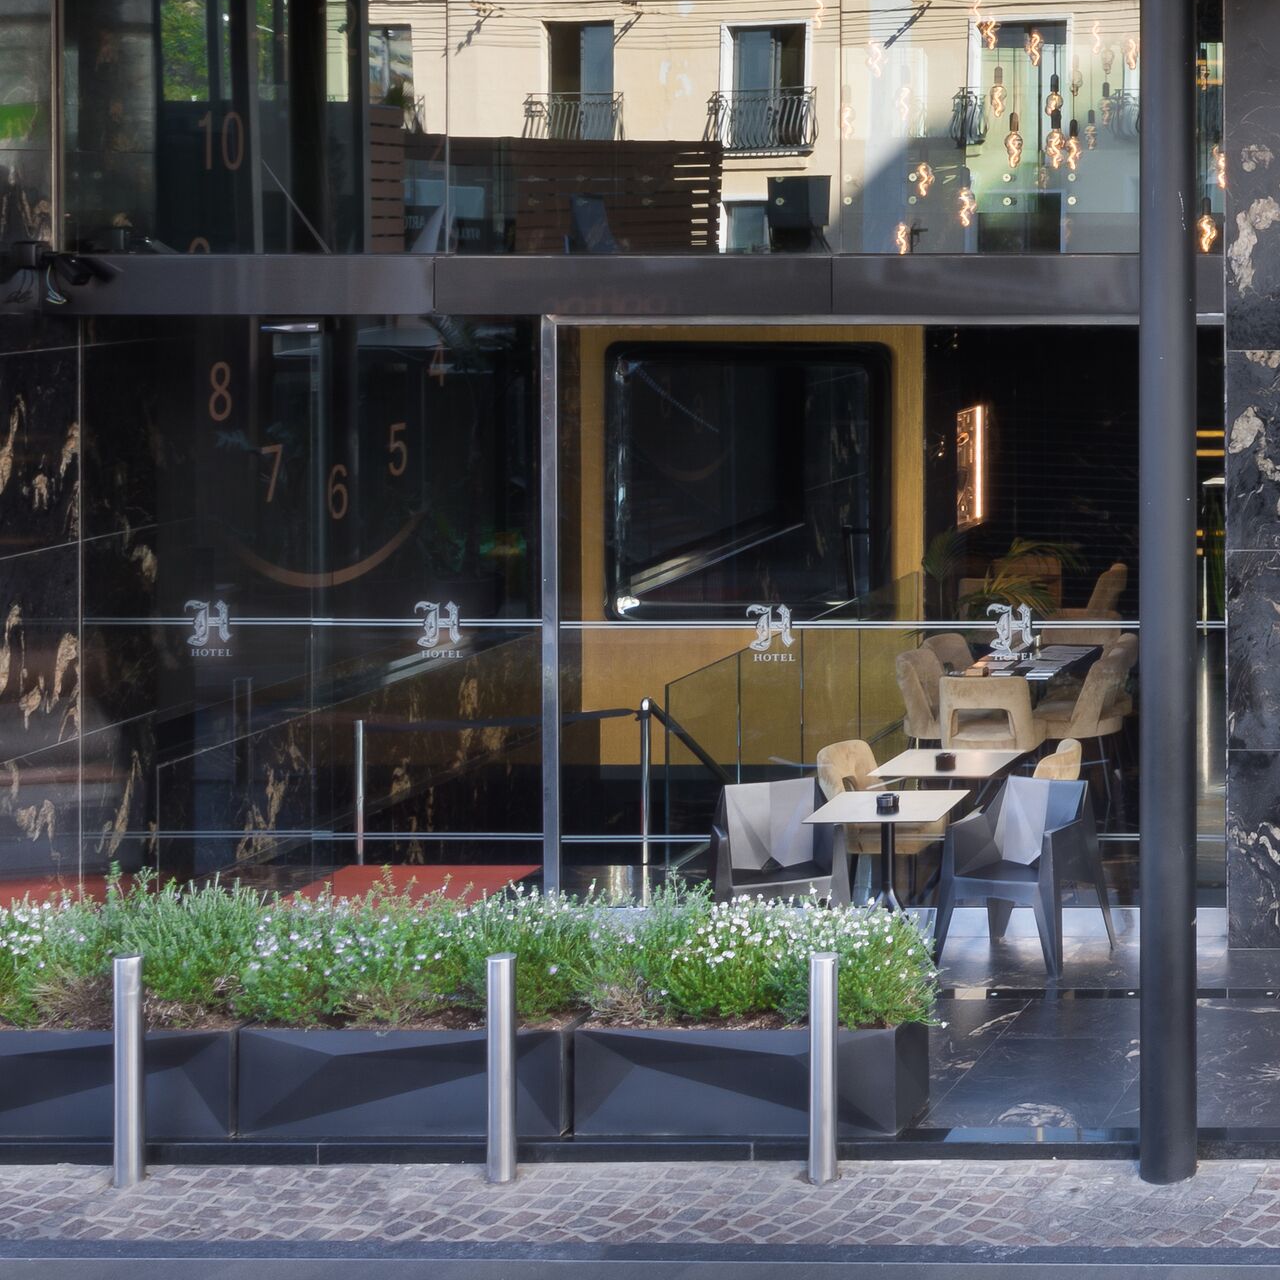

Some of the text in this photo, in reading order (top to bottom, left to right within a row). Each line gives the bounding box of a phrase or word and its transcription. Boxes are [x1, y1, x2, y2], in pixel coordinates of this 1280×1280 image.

[198, 111, 244, 170] 10
[209, 361, 232, 421] 8
[260, 444, 283, 502] 7
[388, 422, 408, 477] 5
[328, 464, 348, 520] 6
[191, 648, 233, 657] HOTEL
[421, 650, 463, 659] HOTEL
[753, 653, 796, 662] HOTEL
[994, 652, 1036, 661] HOTEL
